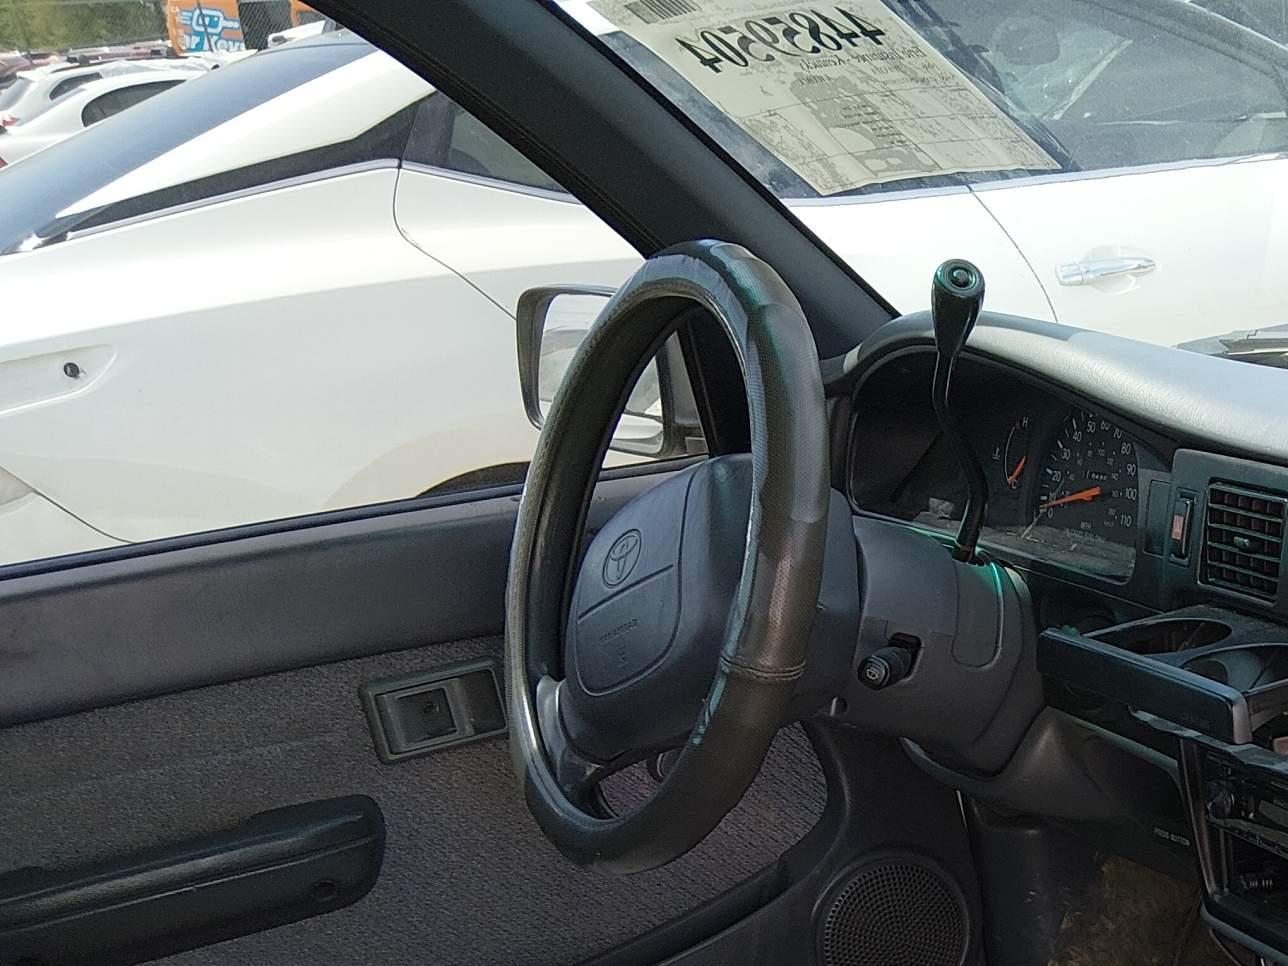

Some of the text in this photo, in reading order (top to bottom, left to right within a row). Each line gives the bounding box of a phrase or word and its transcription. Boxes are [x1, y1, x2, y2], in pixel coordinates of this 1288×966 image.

[1086, 421, 1097, 433] 50
[1073, 431, 1082, 442] 40
[1061, 449, 1071, 460] 30
[1126, 463, 1137, 476] 90
[1125, 488, 1137, 501] 100
[1120, 513, 1132, 528] 110
